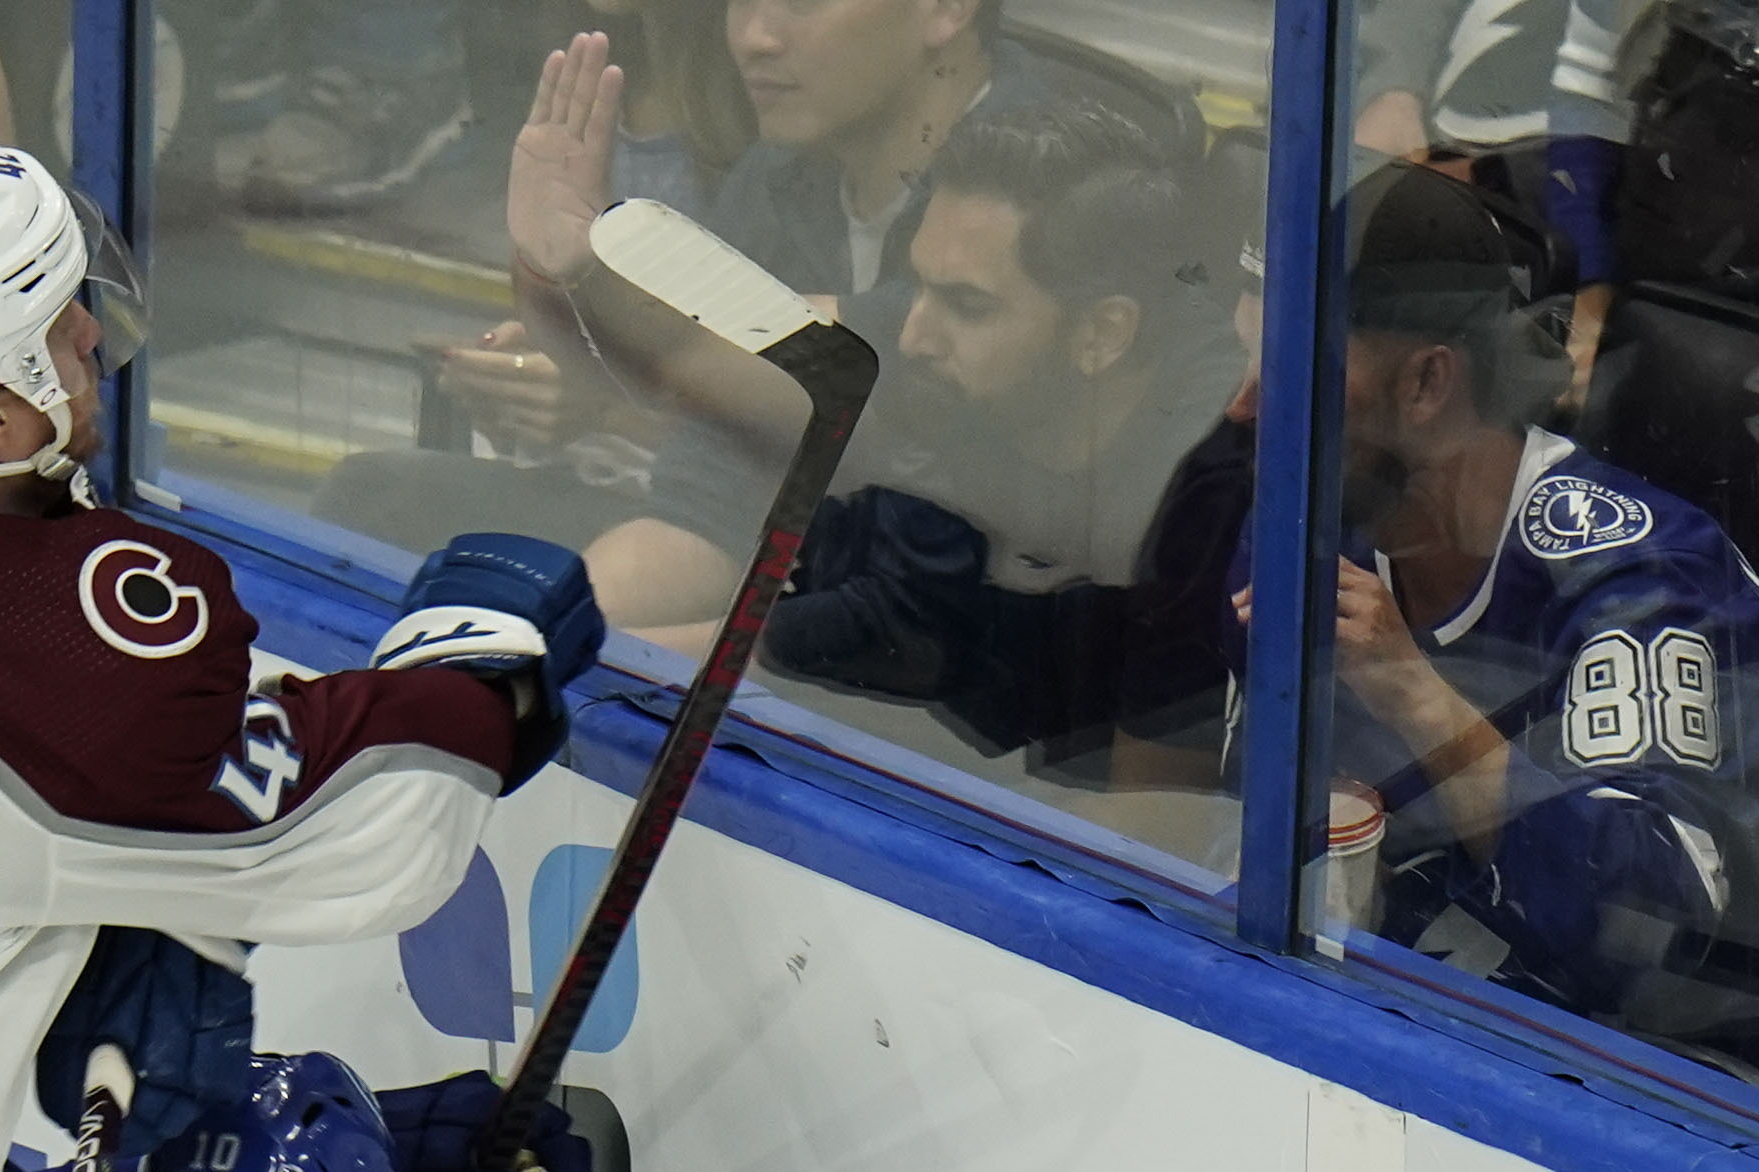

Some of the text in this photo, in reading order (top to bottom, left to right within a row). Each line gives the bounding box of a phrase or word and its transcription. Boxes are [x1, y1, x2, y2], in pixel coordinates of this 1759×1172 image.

[1529, 486, 1551, 516] BAY
[1554, 480, 1643, 522] LIGHTNING
[1529, 520, 1570, 550] TAMPA
[1561, 626, 1722, 772] 88
[191, 1132, 240, 1172] 10
